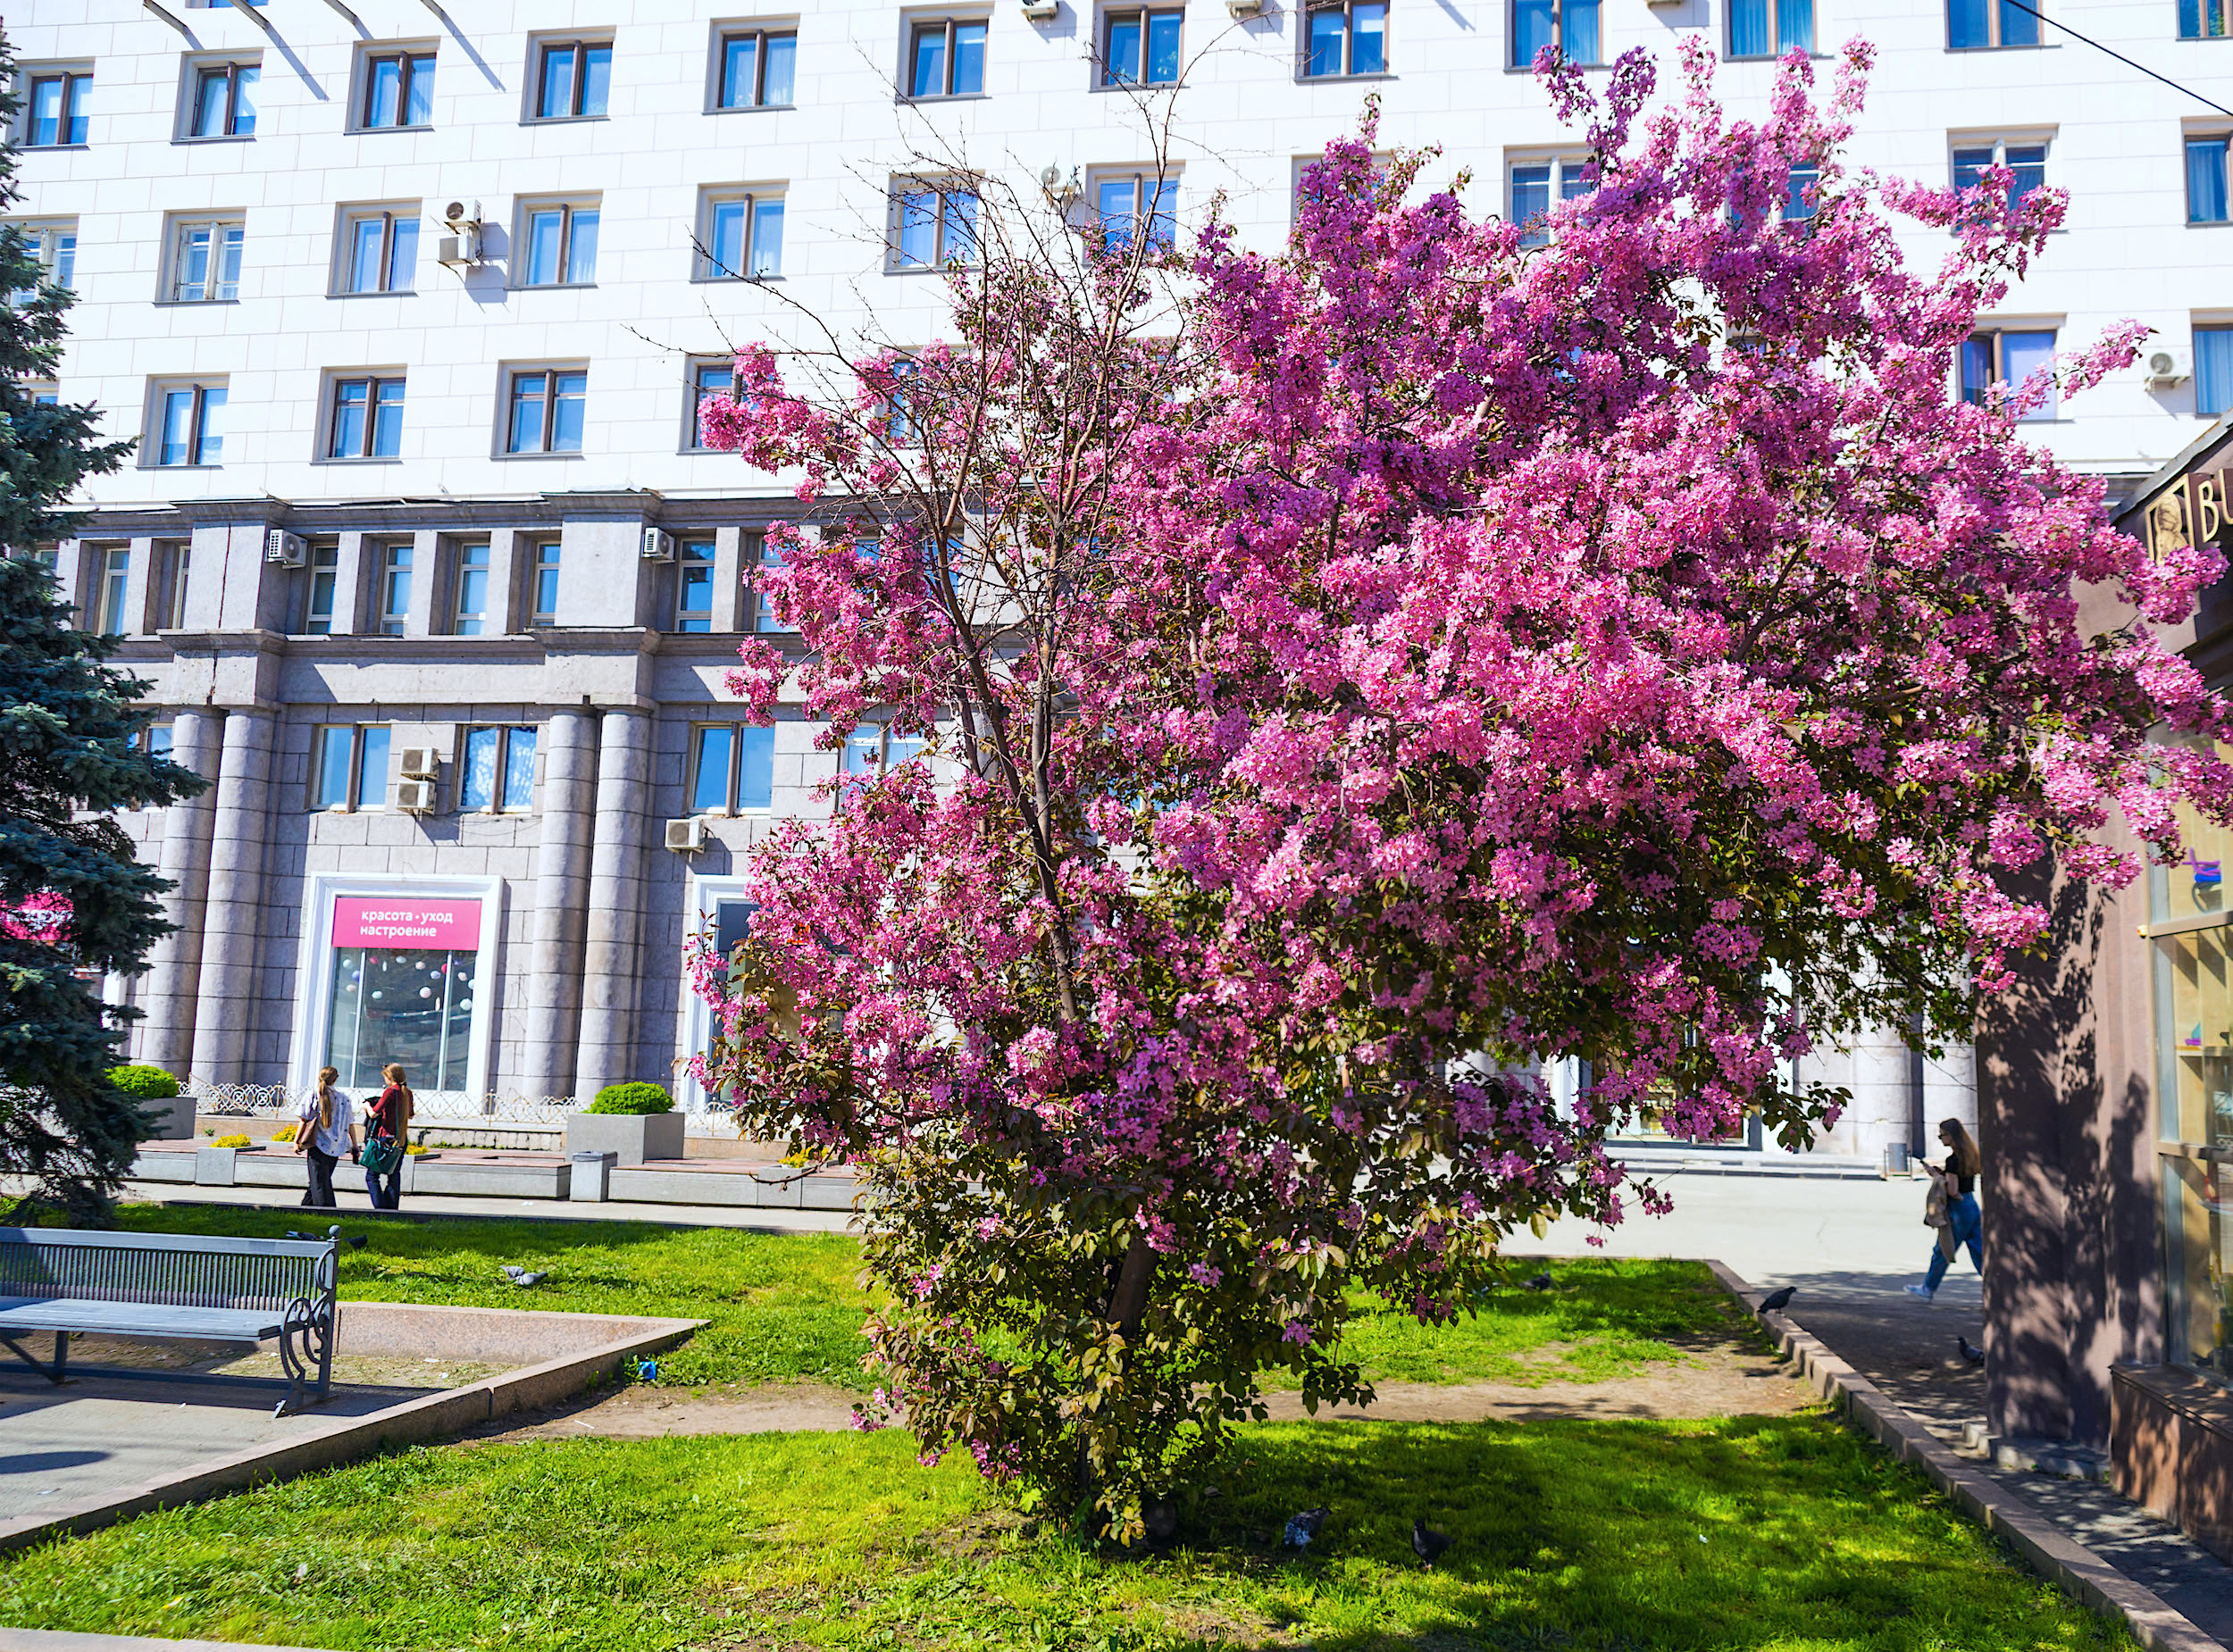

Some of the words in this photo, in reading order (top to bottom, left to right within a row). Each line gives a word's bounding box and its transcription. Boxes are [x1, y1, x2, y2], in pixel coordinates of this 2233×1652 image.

[361, 911, 413, 923] красота
[421, 912, 453, 924] уход
[360, 926, 437, 939] настроение
